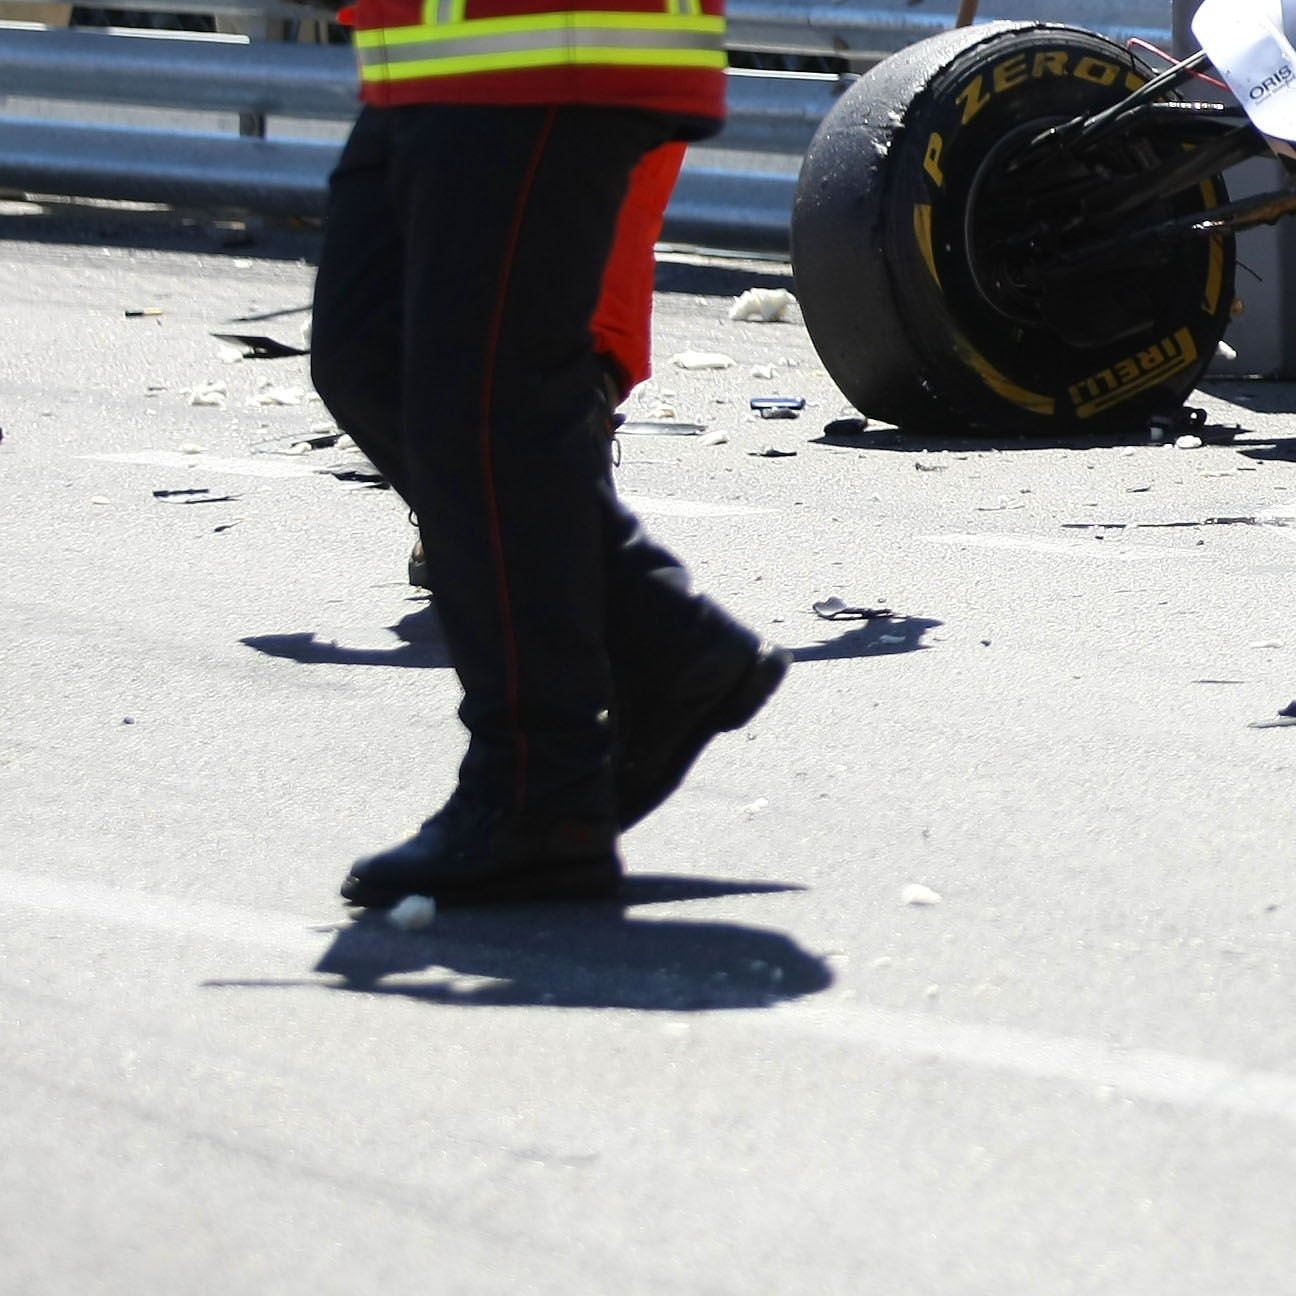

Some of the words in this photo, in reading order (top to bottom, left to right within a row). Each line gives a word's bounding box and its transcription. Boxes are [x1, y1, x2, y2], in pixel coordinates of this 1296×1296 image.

[923, 132, 943, 187] P
[955, 50, 1121, 126] ZERO
[1249, 65, 1292, 100] ORIS
[1068, 326, 1198, 420] PIRELLI
